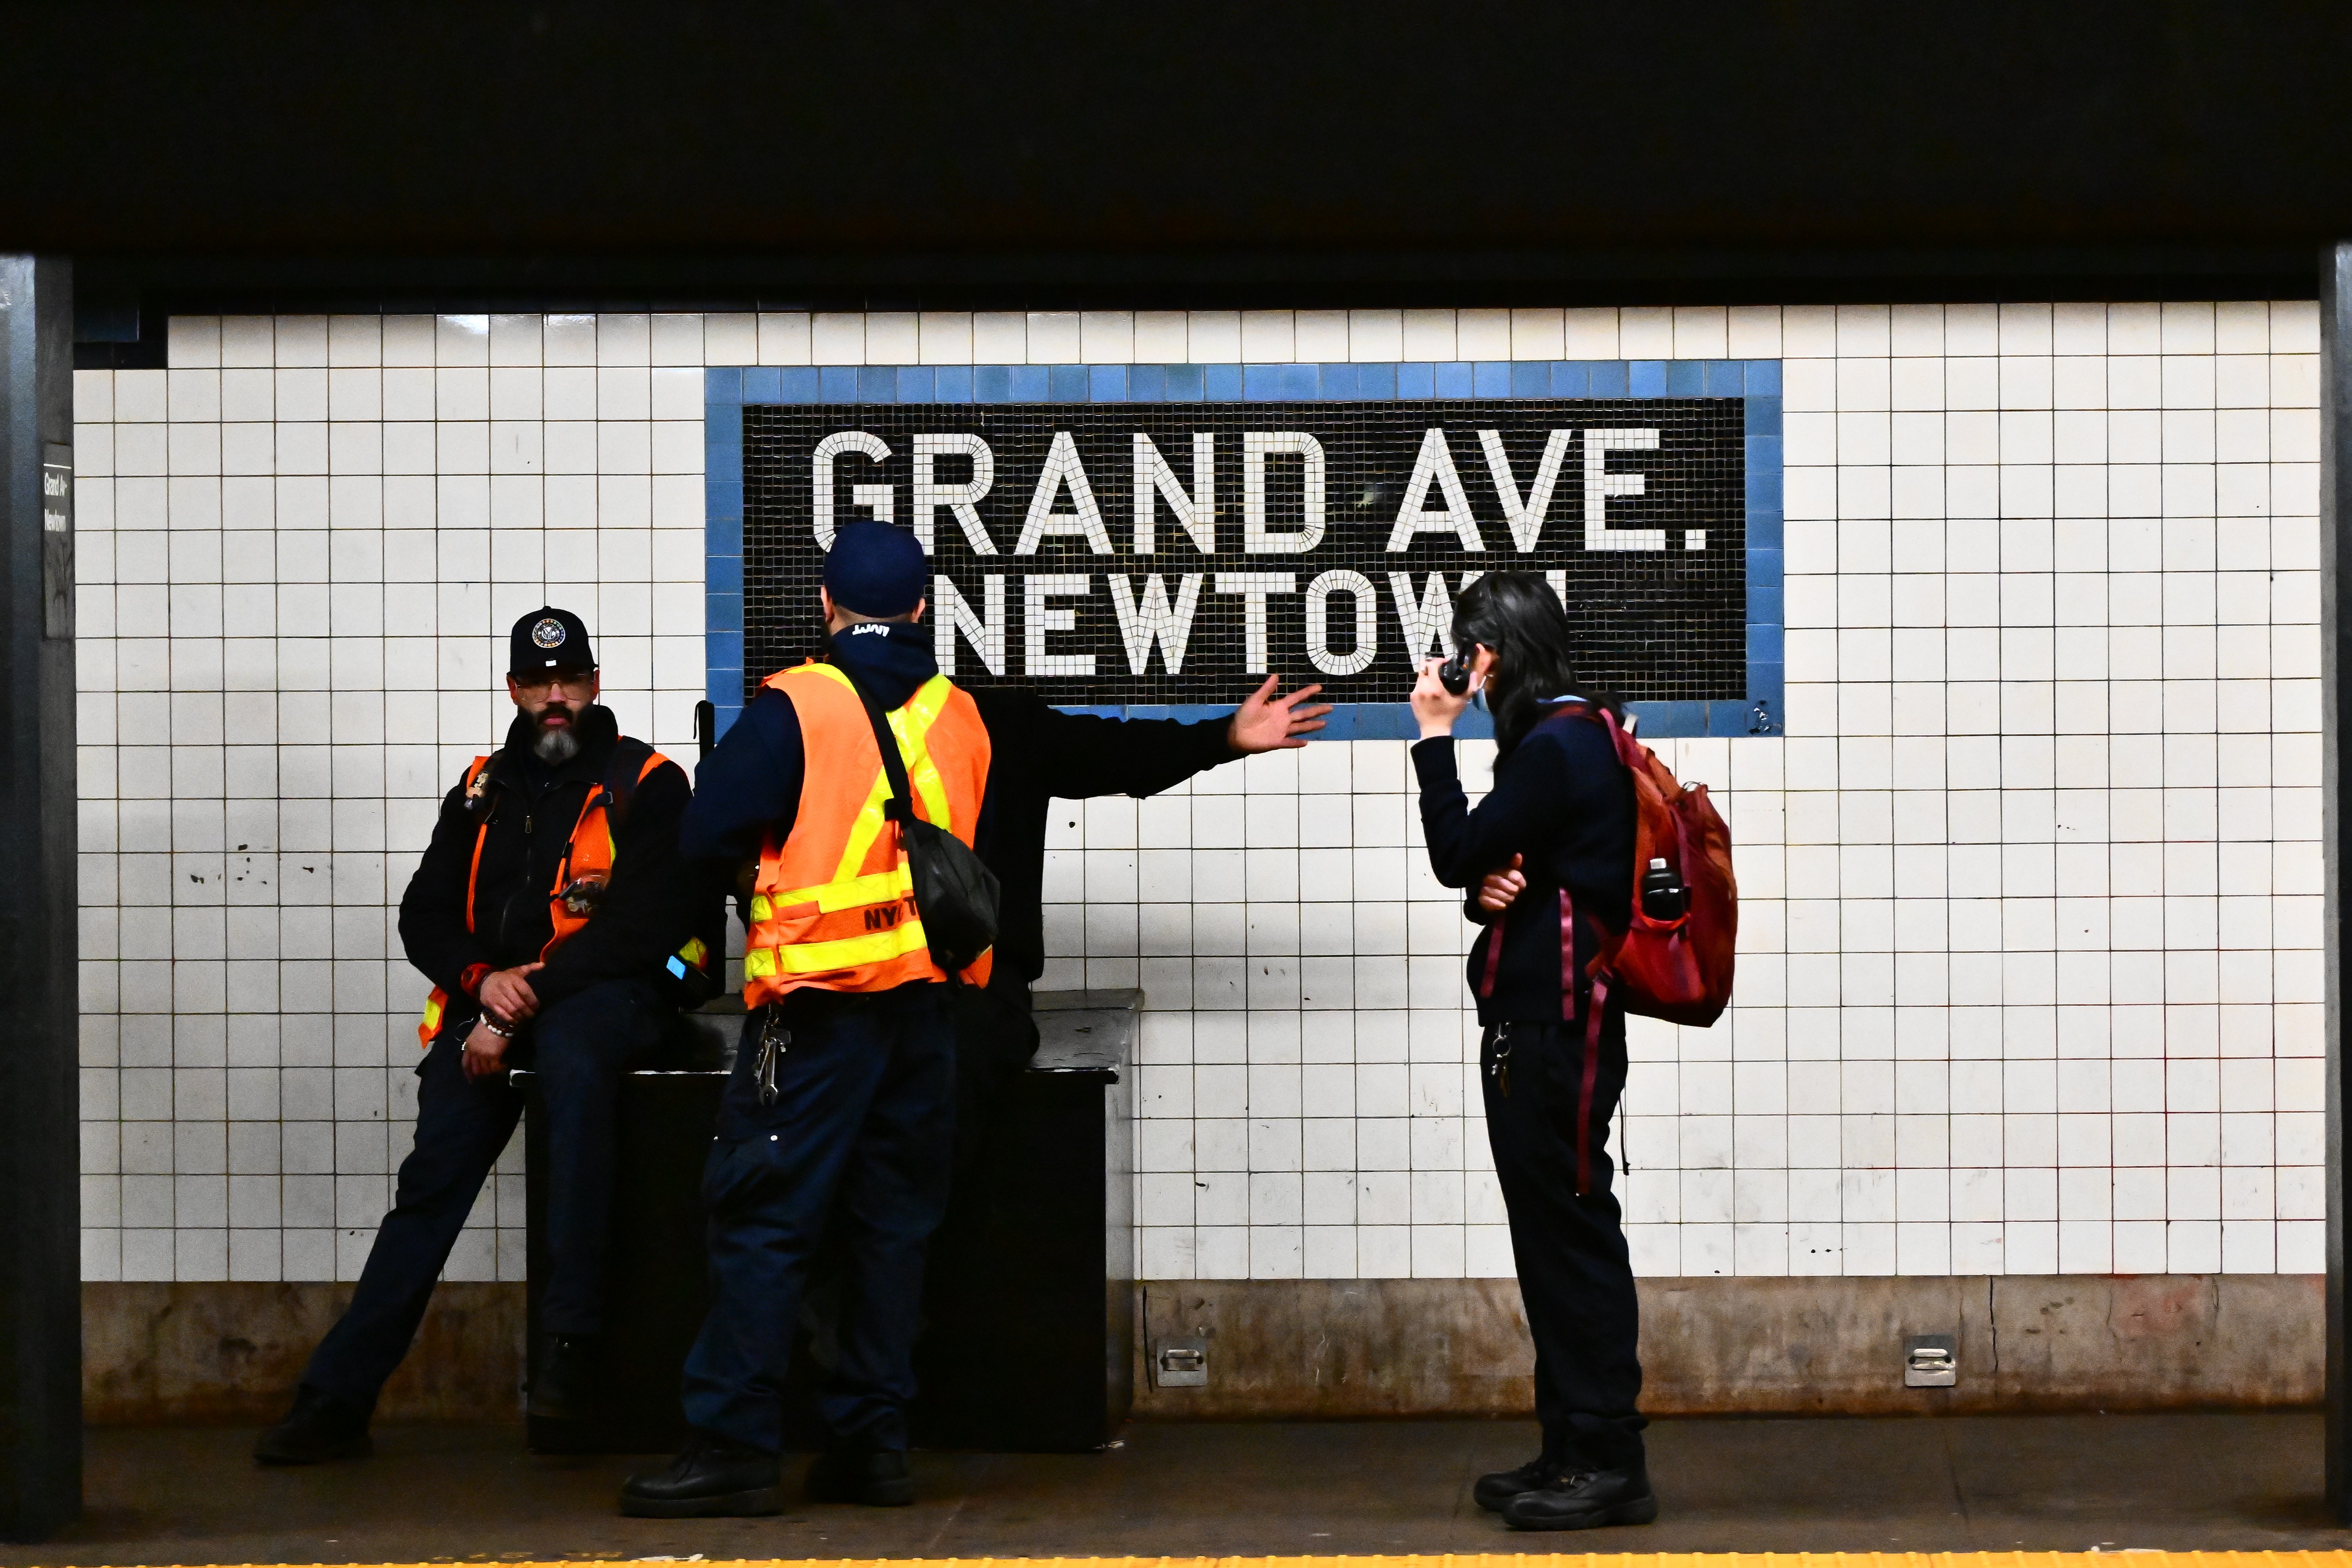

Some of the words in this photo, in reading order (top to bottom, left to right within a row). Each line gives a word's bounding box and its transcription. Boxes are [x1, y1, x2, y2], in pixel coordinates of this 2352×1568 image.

[813, 431, 1325, 555] GRAND
[1386, 428, 1706, 553] AVE.
[934, 570, 1566, 675] NEWTOW
